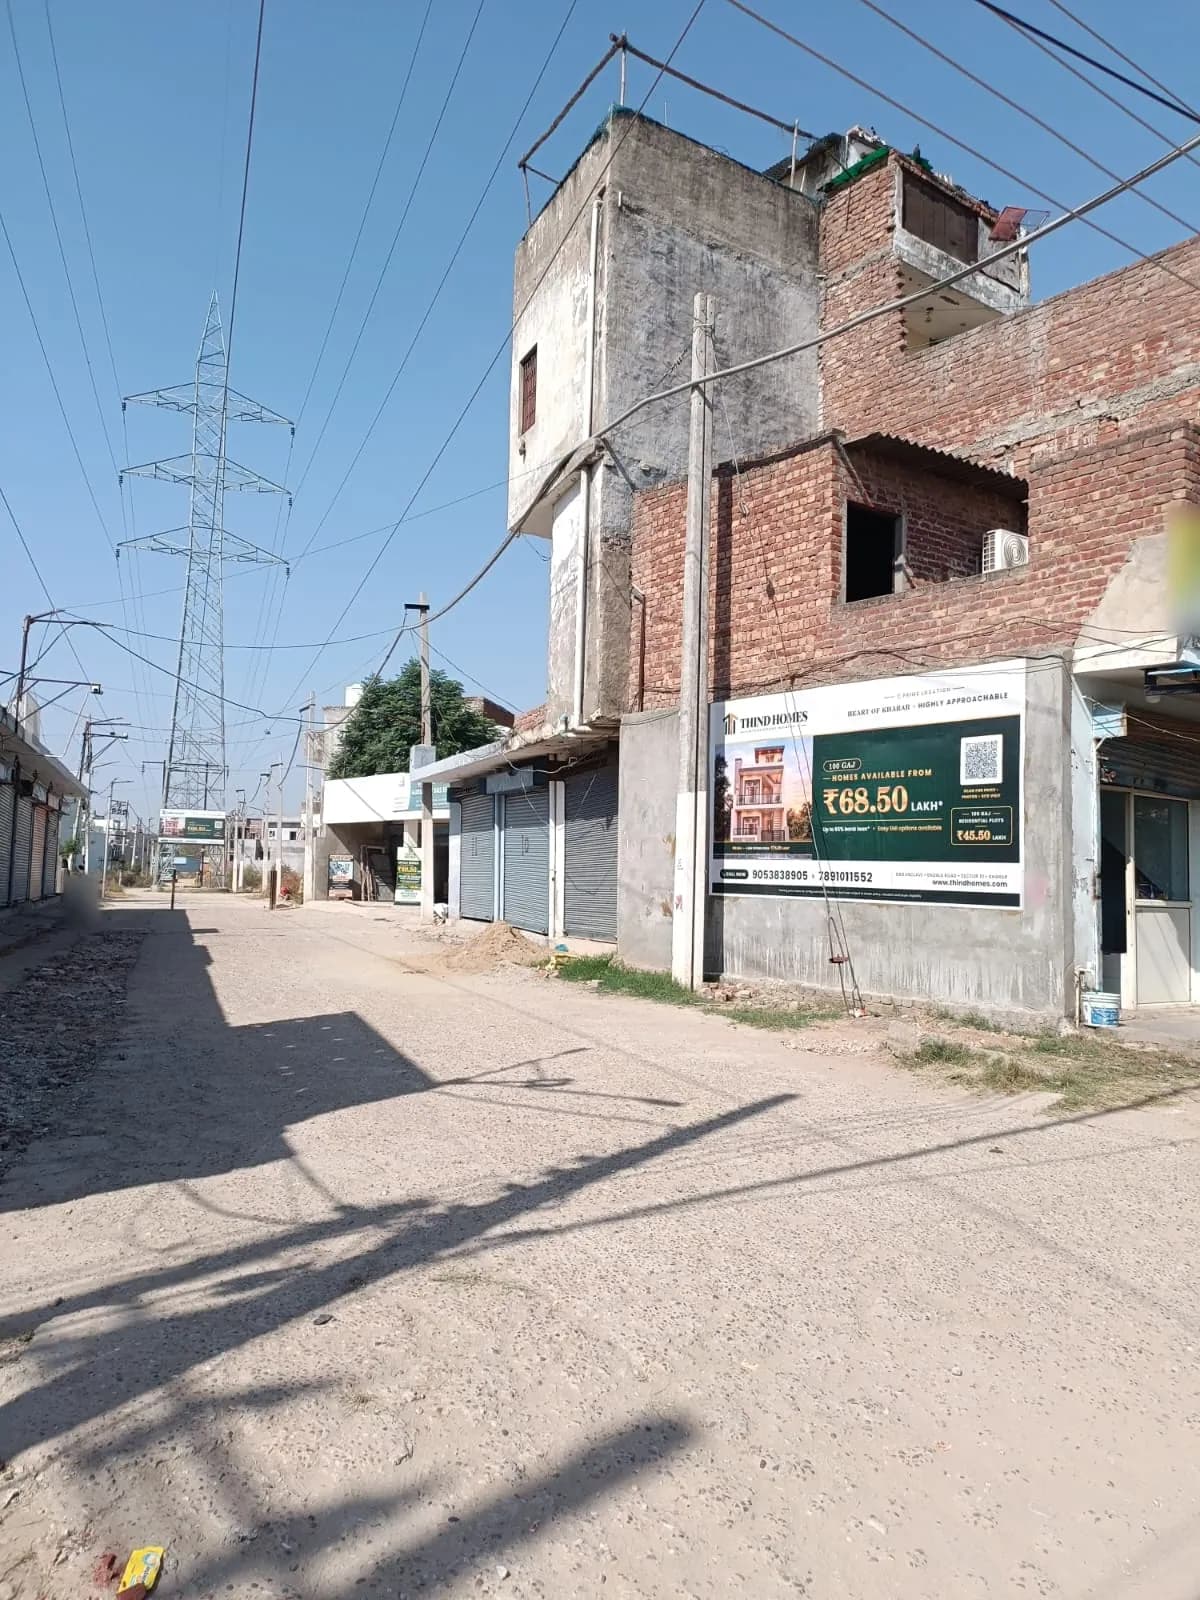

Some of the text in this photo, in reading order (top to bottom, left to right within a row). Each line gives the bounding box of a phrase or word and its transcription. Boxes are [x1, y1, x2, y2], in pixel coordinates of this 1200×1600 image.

[848, 708, 869, 717] HEART
[882, 704, 911, 713] KHARAR
[918, 700, 944, 709] HIGHLY
[946, 692, 1008, 705] APPROACHABLE
[740, 715, 771, 729] THIND
[772, 711, 808, 725] HOMES
[828, 761, 856, 770] 100 GAJ
[831, 768, 933, 782] HOMES AVAILABLE FROM
[823, 785, 909, 815] ₹68.50
[752, 869, 873, 883] 9053838905 7891011552
[932, 879, 1008, 888] www.thindhomes.com
